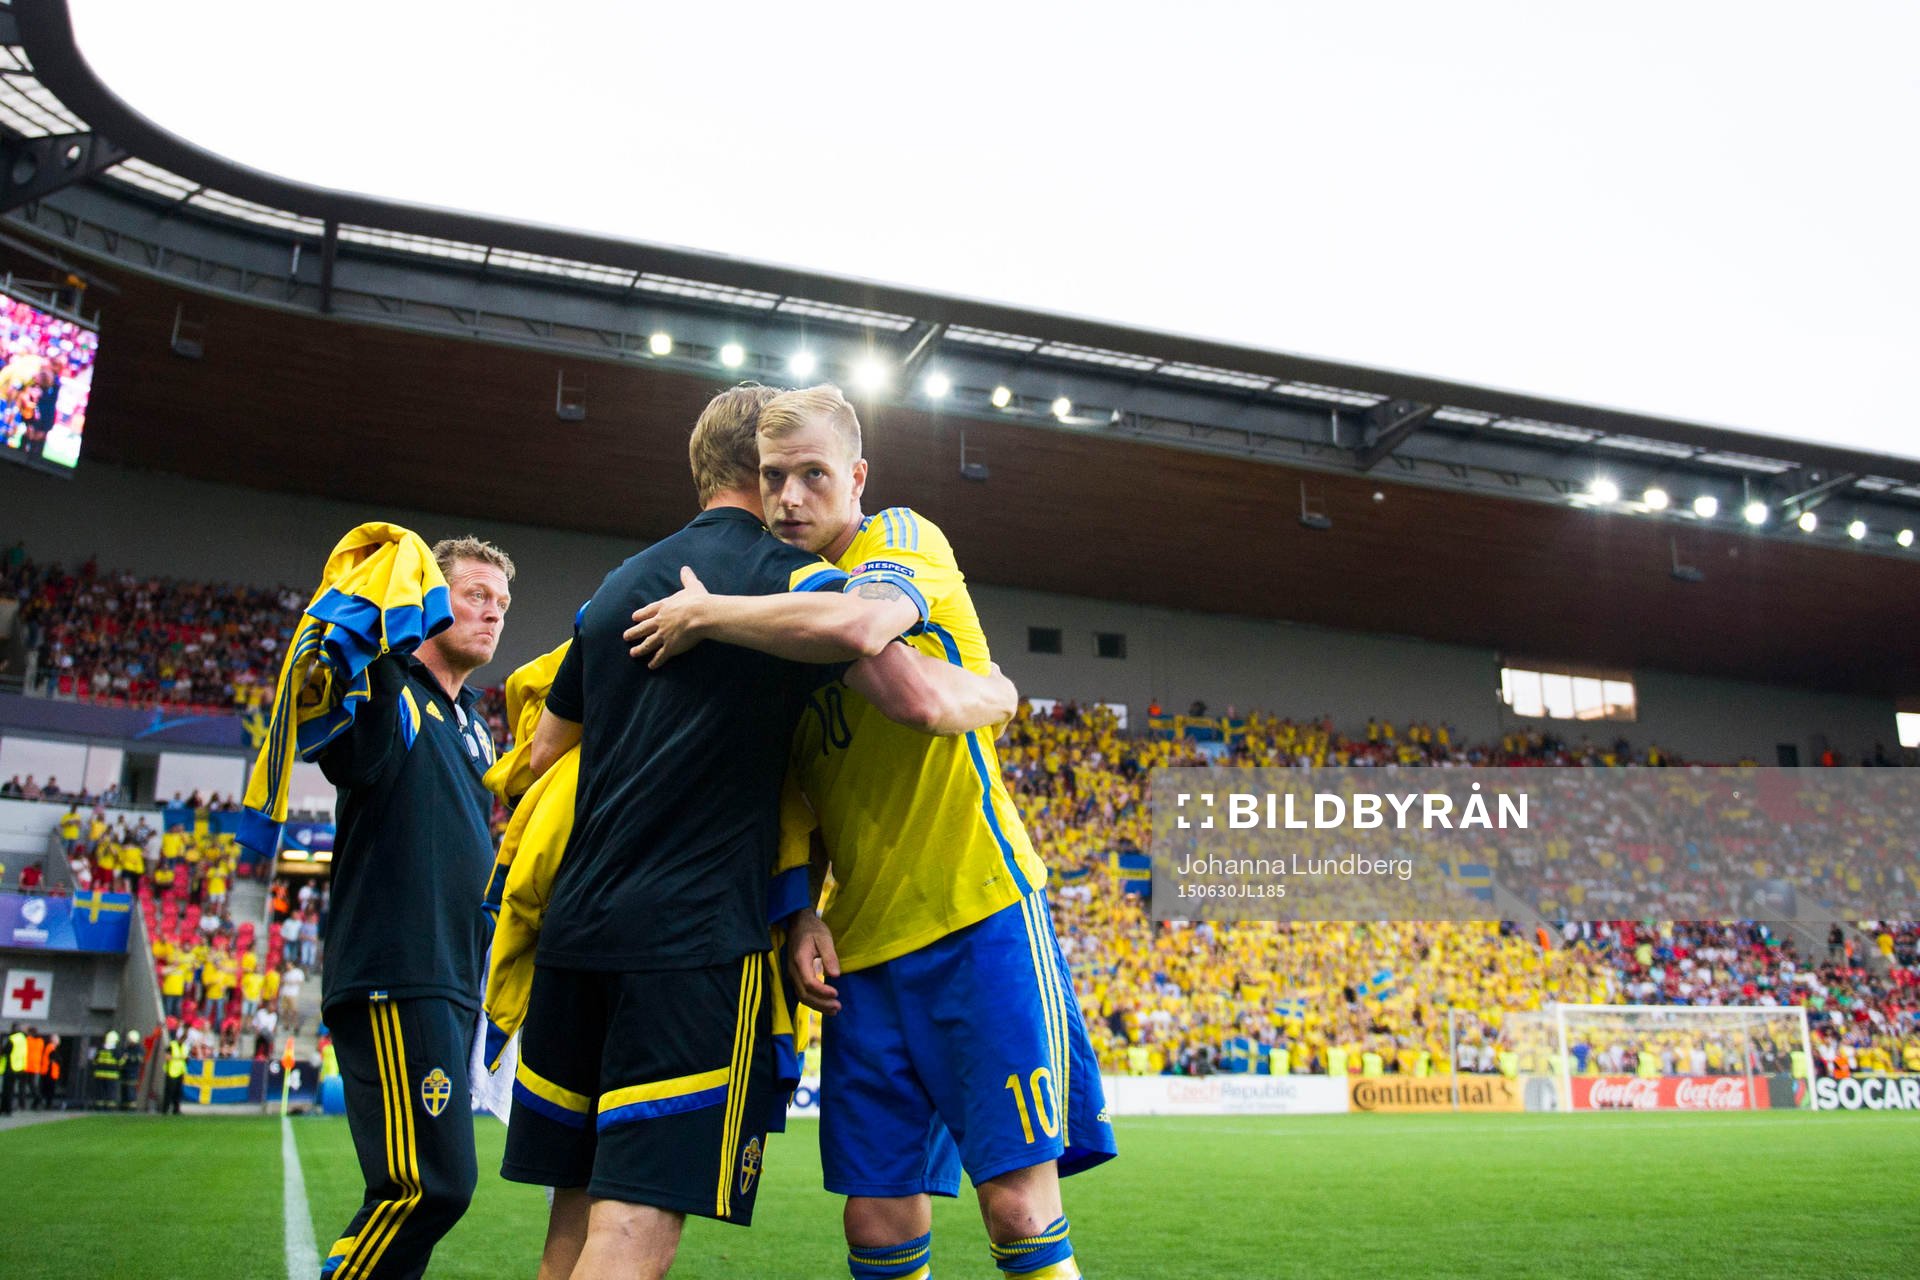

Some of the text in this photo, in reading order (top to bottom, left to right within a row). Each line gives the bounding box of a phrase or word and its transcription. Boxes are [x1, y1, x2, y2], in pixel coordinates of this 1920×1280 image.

[866, 562, 915, 577] RESPECT
[808, 687, 853, 757] 10
[1005, 1066, 1059, 1145] 10
[1352, 1080, 1492, 1111] Continental
[1816, 1076, 1920, 1111] SOCAR
